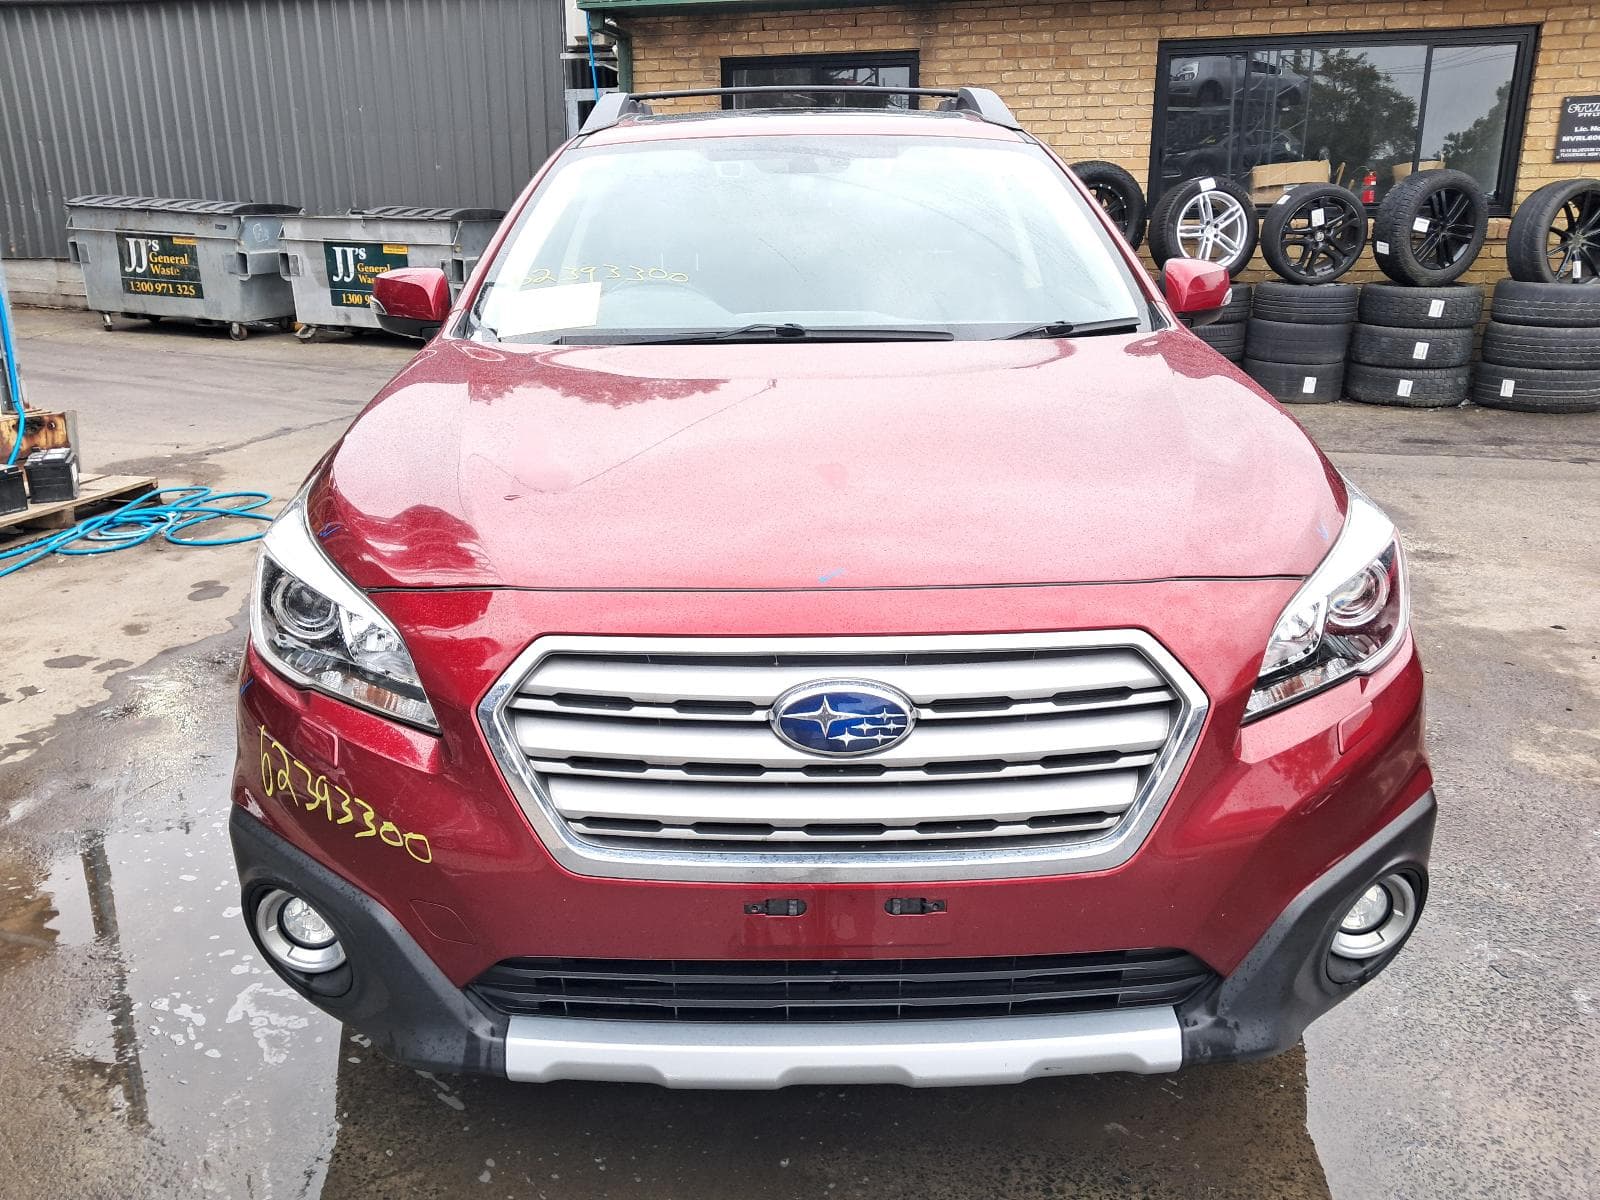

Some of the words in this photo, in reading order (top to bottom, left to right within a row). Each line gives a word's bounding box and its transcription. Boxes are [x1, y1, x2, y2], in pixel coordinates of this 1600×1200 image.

[148, 251, 189, 265] General
[150, 264, 180, 276] Waste
[357, 262, 391, 273] General
[358, 274, 375, 284] Was
[130, 281, 154, 293] 1300
[155, 282, 174, 294] 971
[177, 284, 196, 296] 325
[342, 293, 363, 305] 1300
[258, 725, 432, 863] 62393300
